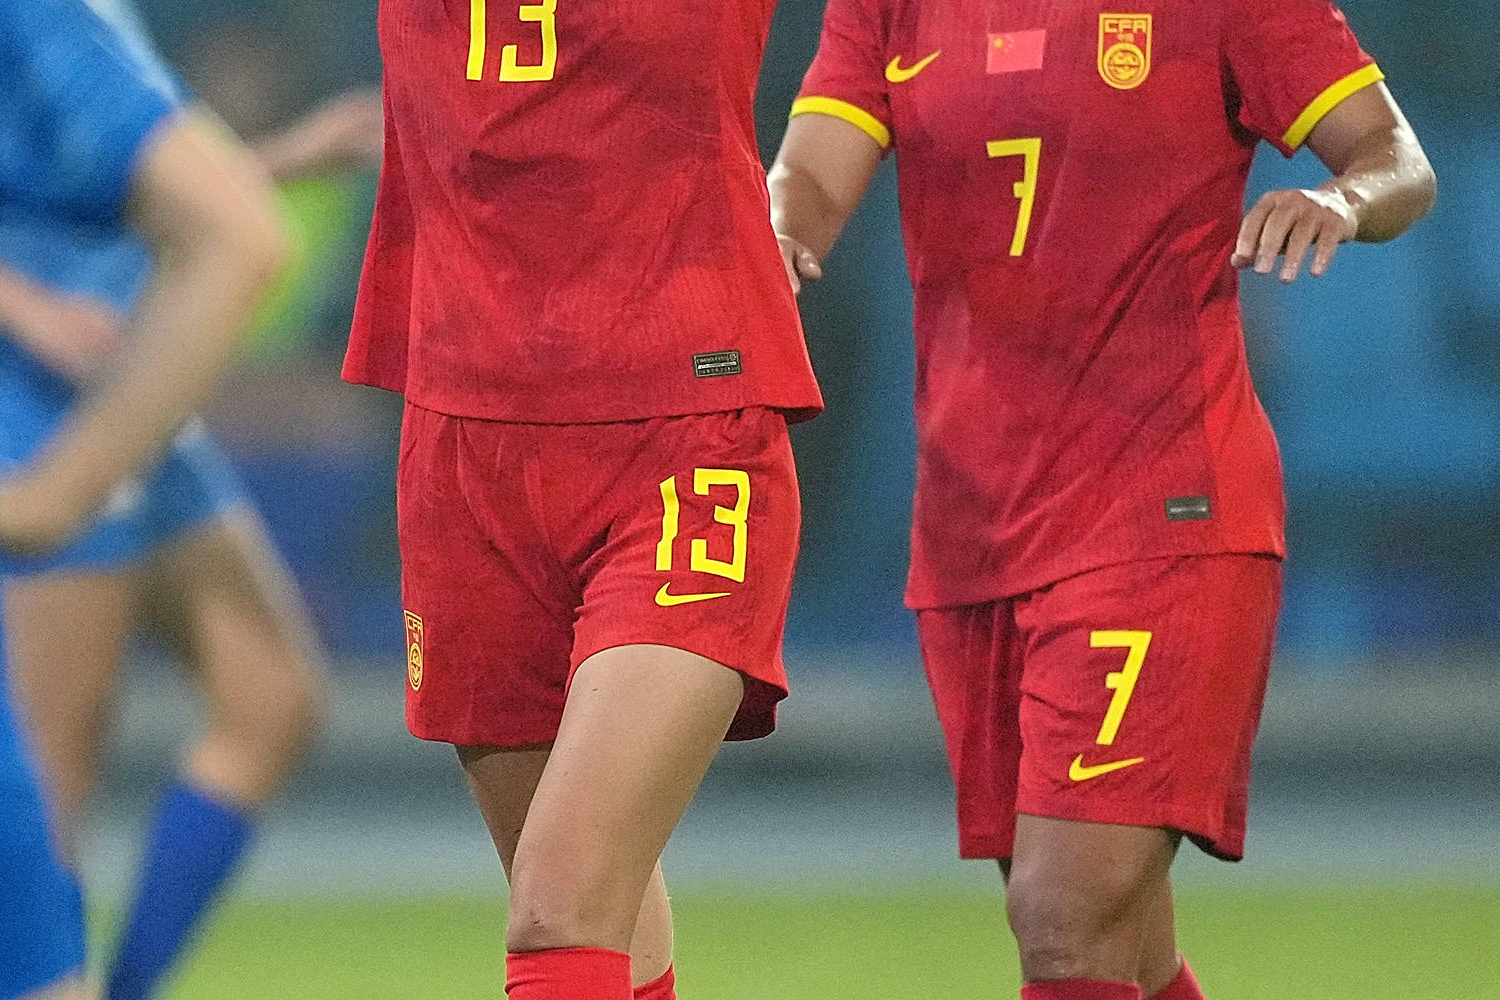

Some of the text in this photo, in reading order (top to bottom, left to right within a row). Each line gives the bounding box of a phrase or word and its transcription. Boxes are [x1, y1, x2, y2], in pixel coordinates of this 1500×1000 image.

[1104, 19, 1148, 34] CFA
[986, 137, 1042, 257] 7
[656, 467, 752, 583] 13
[1090, 630, 1152, 745] 7
